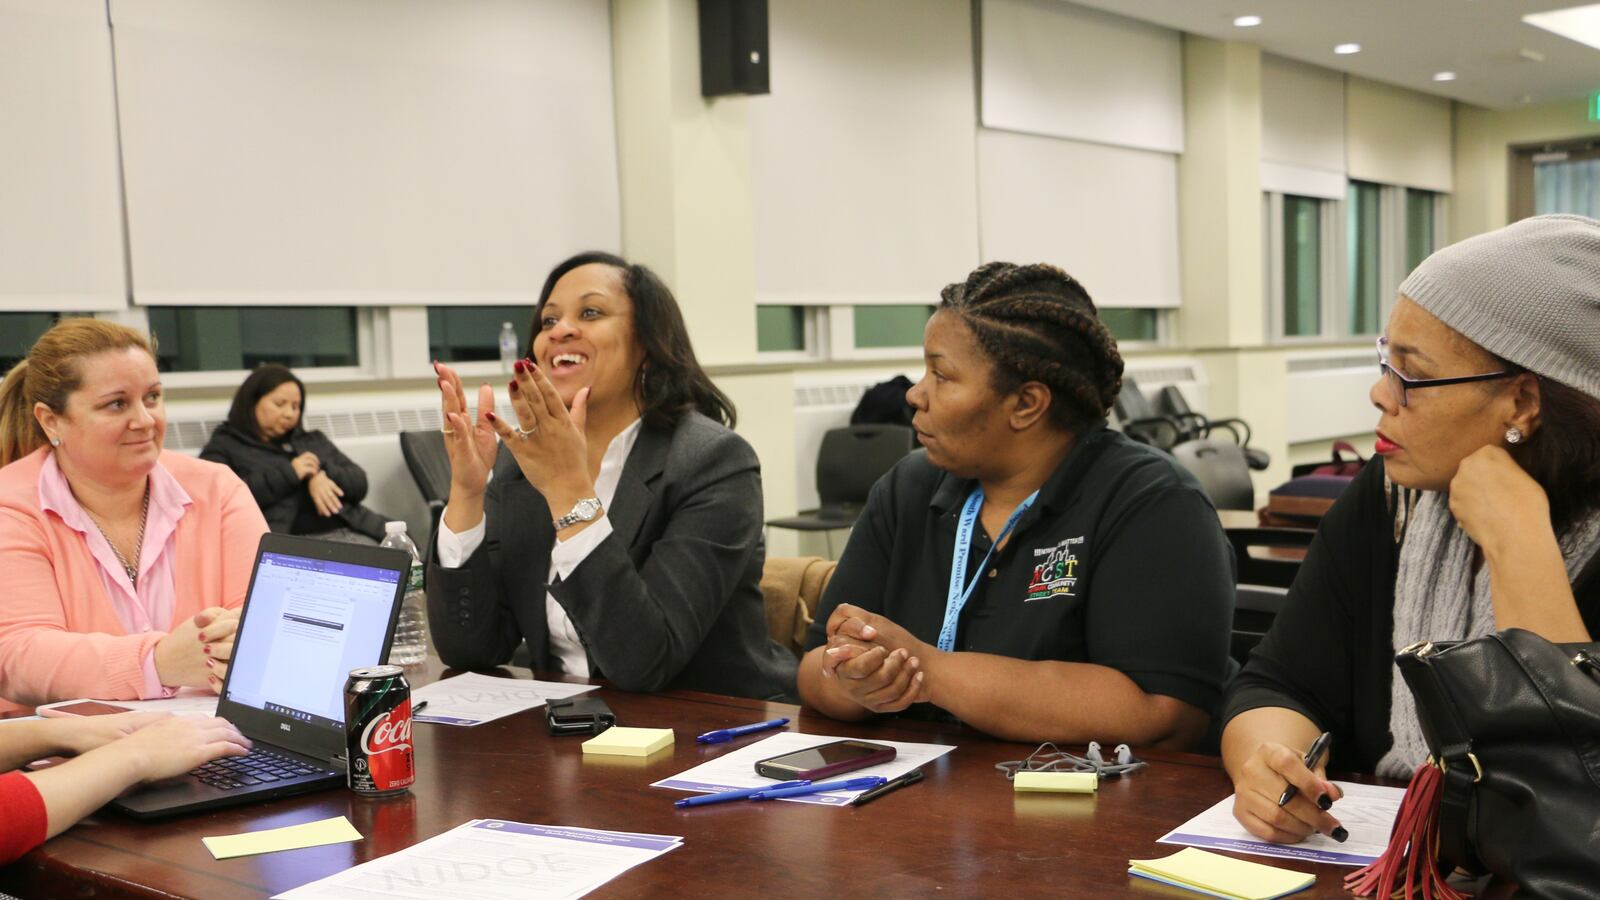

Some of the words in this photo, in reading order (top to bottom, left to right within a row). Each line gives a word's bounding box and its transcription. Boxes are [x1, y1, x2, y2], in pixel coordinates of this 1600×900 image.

[966, 493, 982, 516] South
[960, 517, 972, 545] Ward
[434, 689, 541, 706] DRAF
[360, 711, 412, 755] Coca
